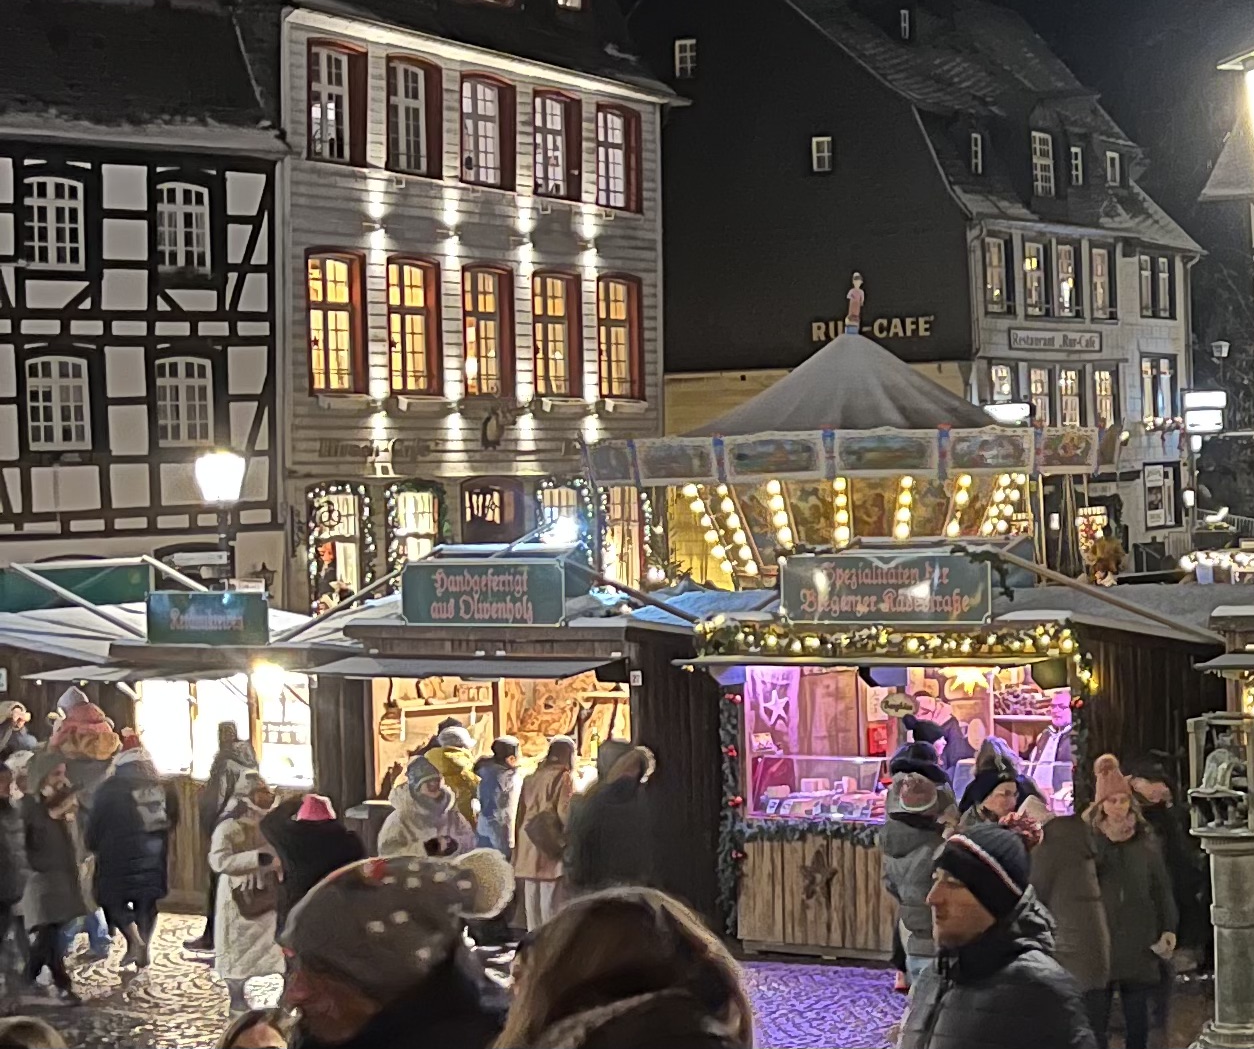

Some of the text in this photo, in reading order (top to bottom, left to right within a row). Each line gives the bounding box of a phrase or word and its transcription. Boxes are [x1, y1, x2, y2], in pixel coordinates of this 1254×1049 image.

[433, 567, 529, 598] Handgefertigt
[430, 595, 534, 624] aus Olivenholz
